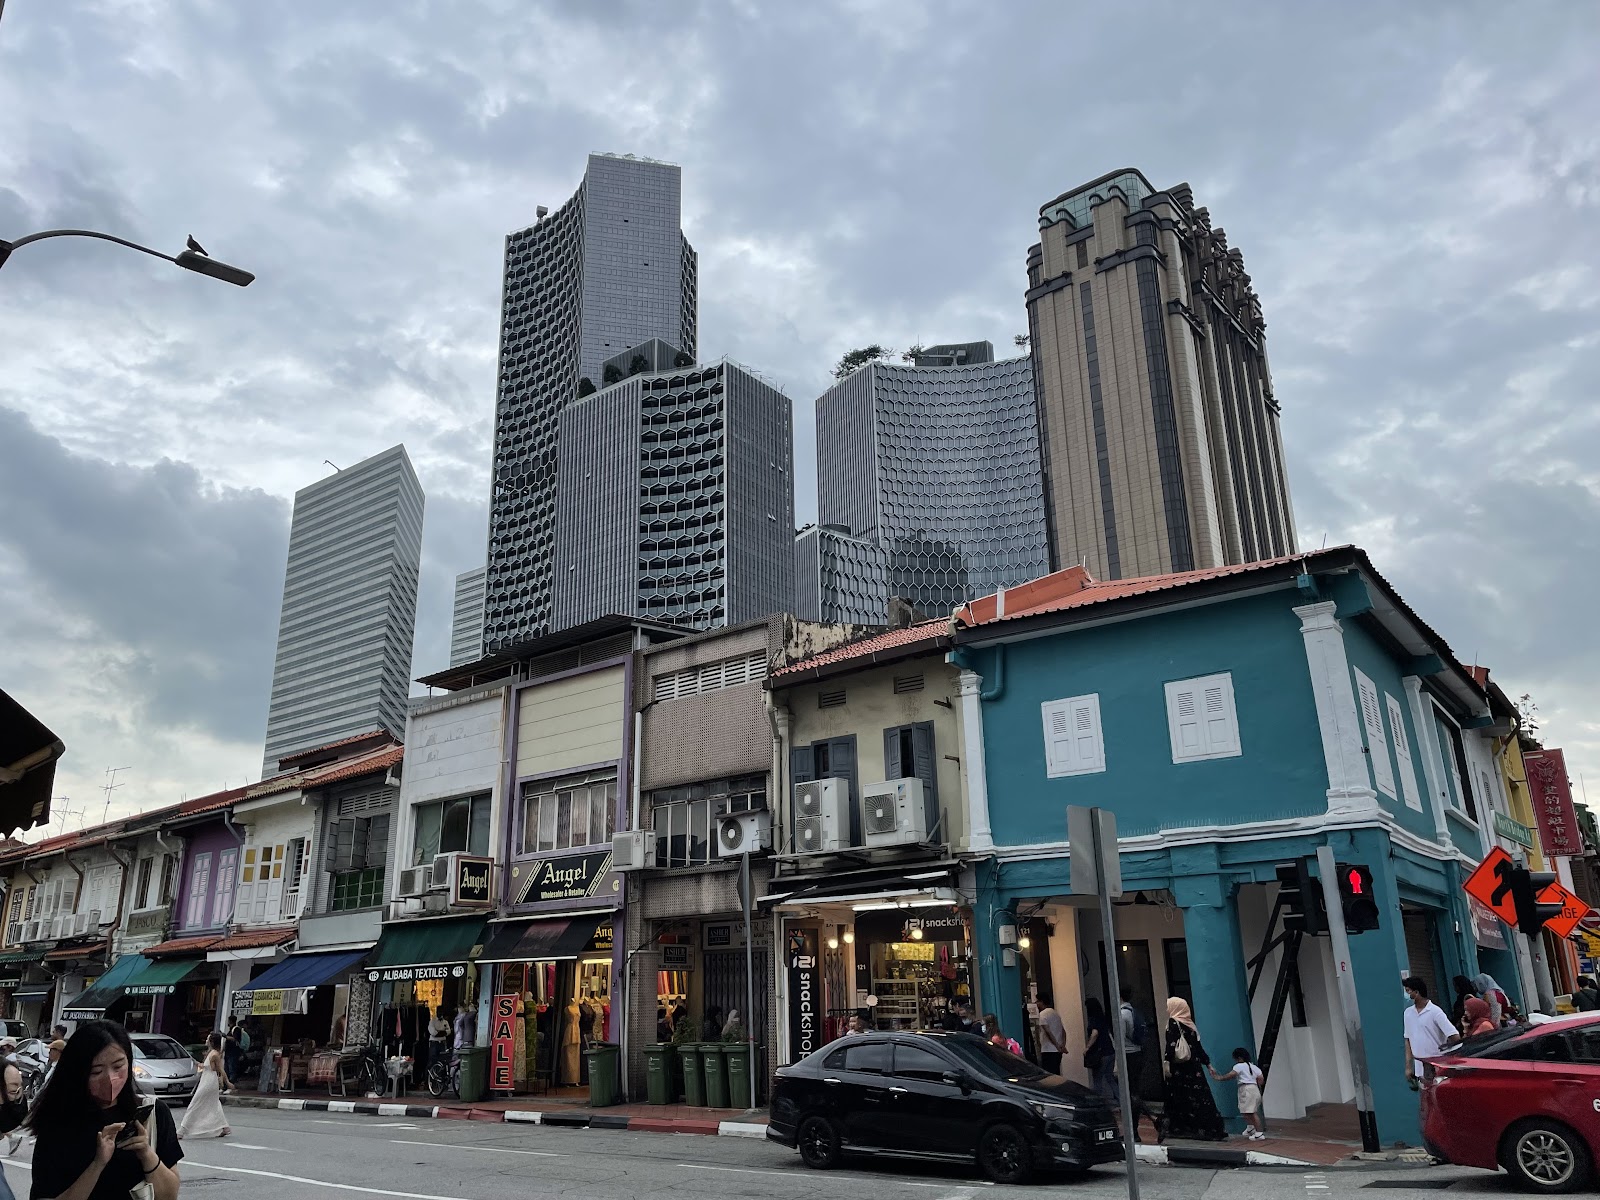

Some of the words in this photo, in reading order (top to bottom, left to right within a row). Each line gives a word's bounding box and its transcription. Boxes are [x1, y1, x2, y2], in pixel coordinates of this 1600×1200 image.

[460, 867, 488, 894] Angel
[541, 859, 588, 888] Angel
[540, 890, 564, 899] Wholesaler
[564, 889, 568, 897] &
[568, 888, 585, 896] Retailer
[369, 972, 379, 981] 115
[383, 969, 413, 980] ALIBABA
[415, 966, 448, 978] TEXTILES
[453, 967, 464, 976] 115
[149, 985, 168, 994] COMPANY
[234, 999, 253, 1008] CARPET
[495, 997, 513, 1087] SALE
